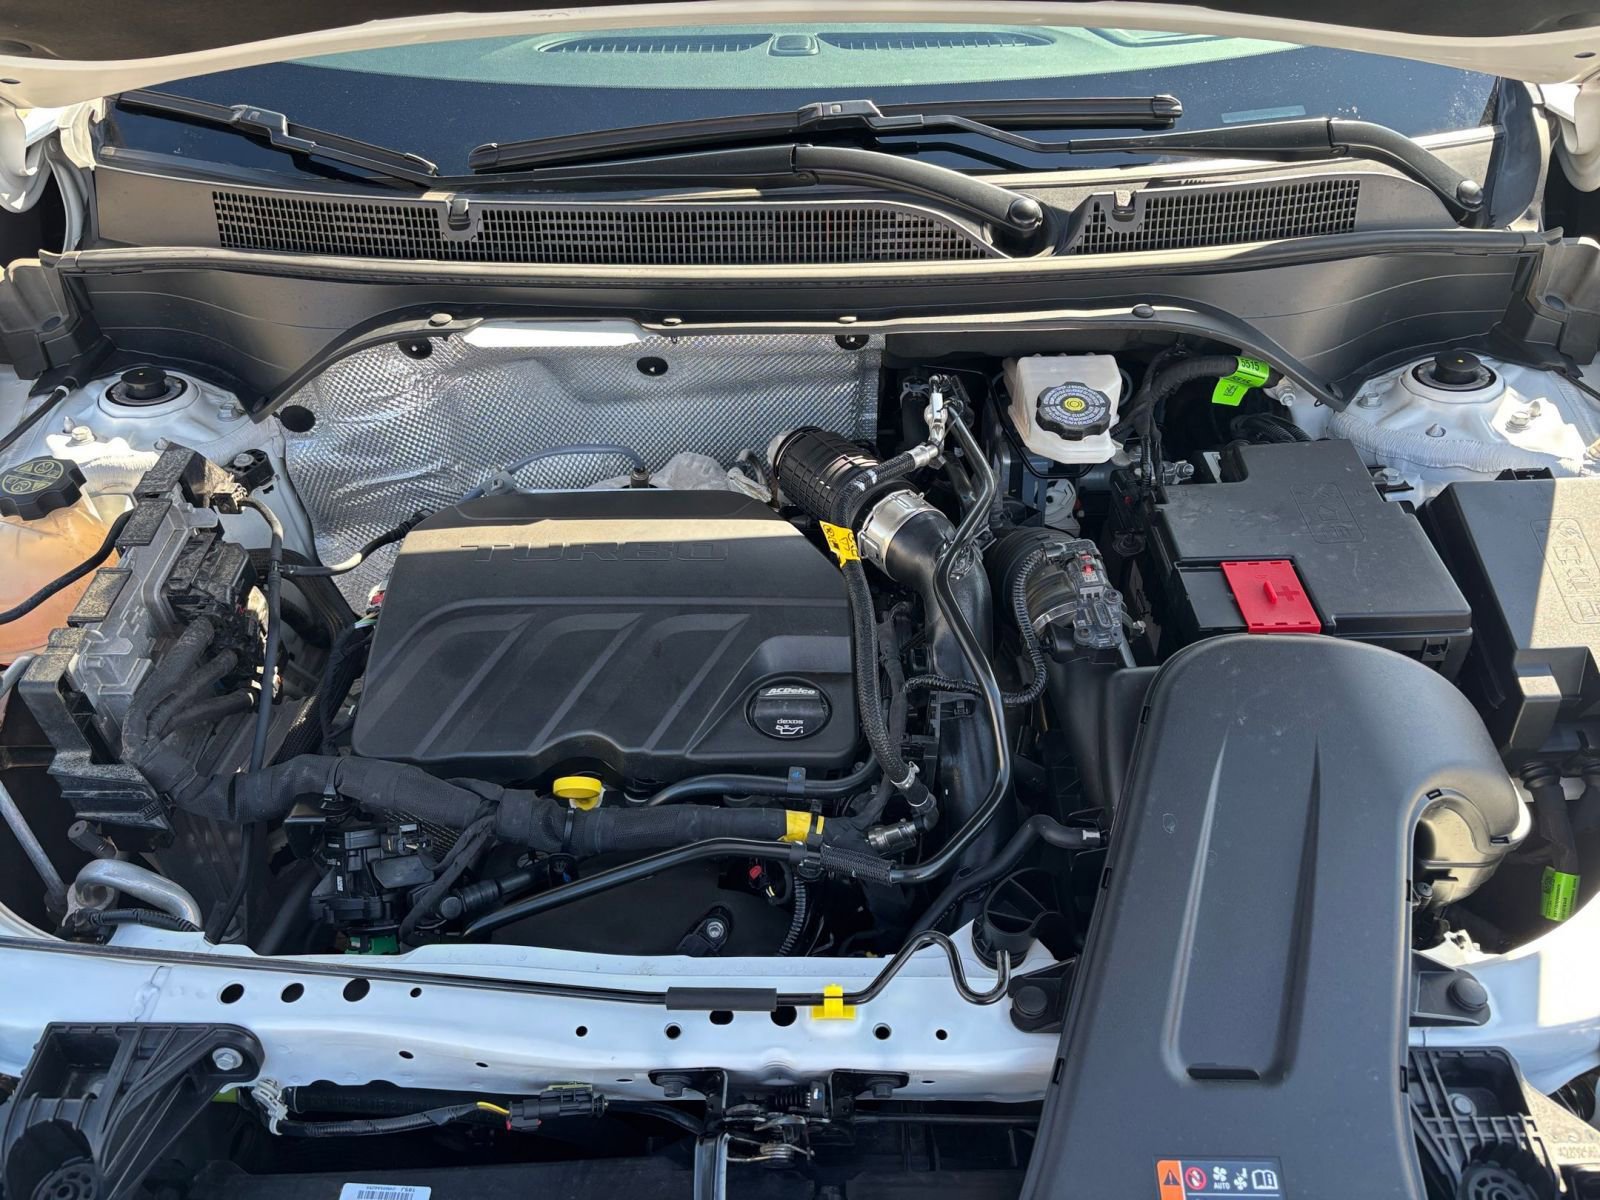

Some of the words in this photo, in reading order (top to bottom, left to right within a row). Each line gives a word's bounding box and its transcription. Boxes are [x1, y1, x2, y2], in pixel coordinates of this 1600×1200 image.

[460, 541, 728, 562] TURBO
[765, 687, 816, 696] ACDelco
[1213, 1182, 1231, 1190] AUTO
